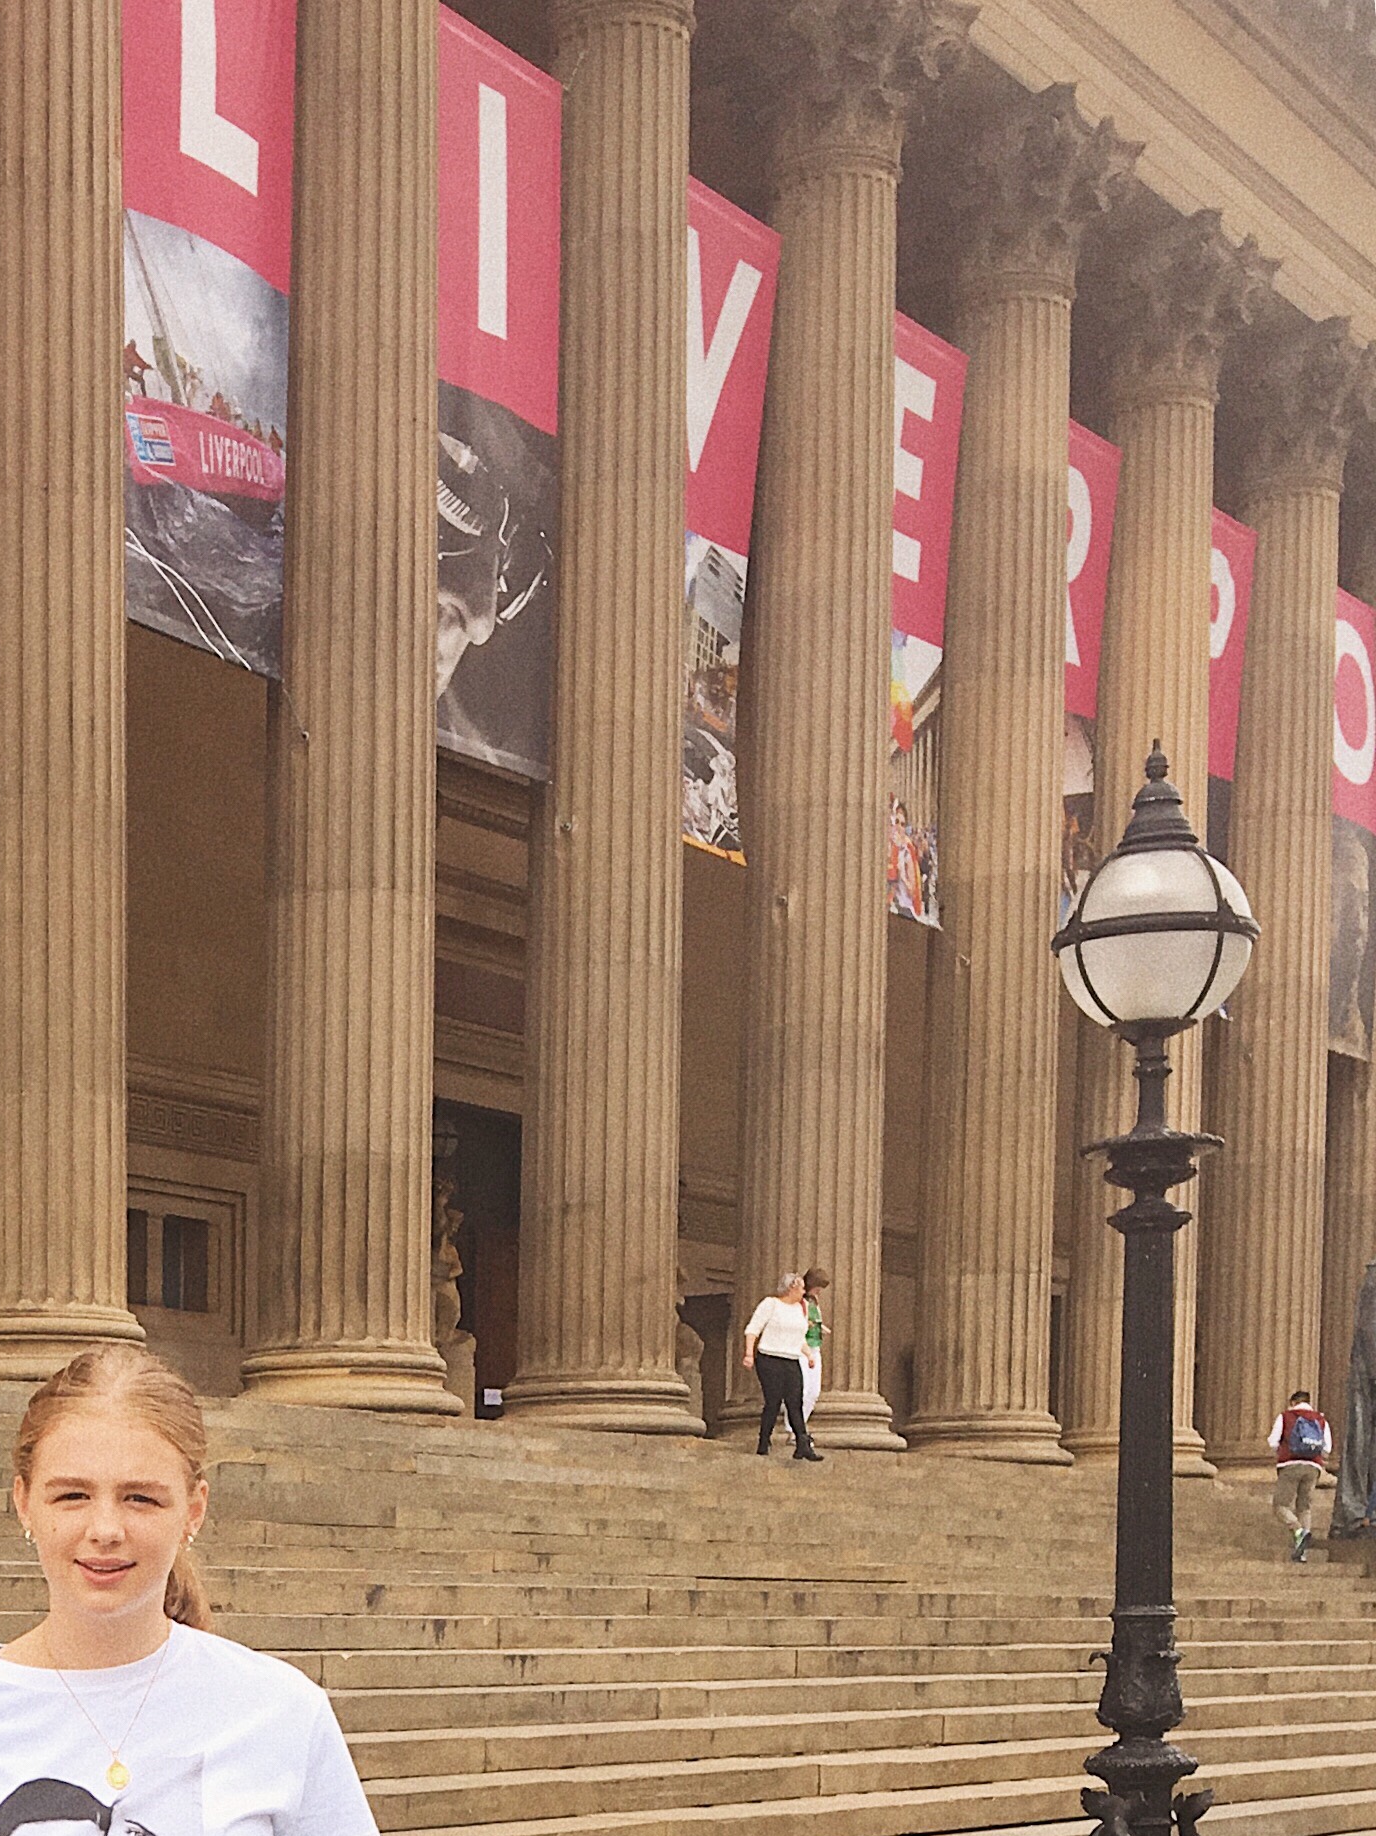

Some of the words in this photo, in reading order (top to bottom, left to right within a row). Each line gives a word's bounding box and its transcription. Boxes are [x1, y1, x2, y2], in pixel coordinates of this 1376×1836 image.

[179, 0, 259, 198] L
[477, 81, 508, 340] I
[198, 430, 265, 485] LIVERPOOL
